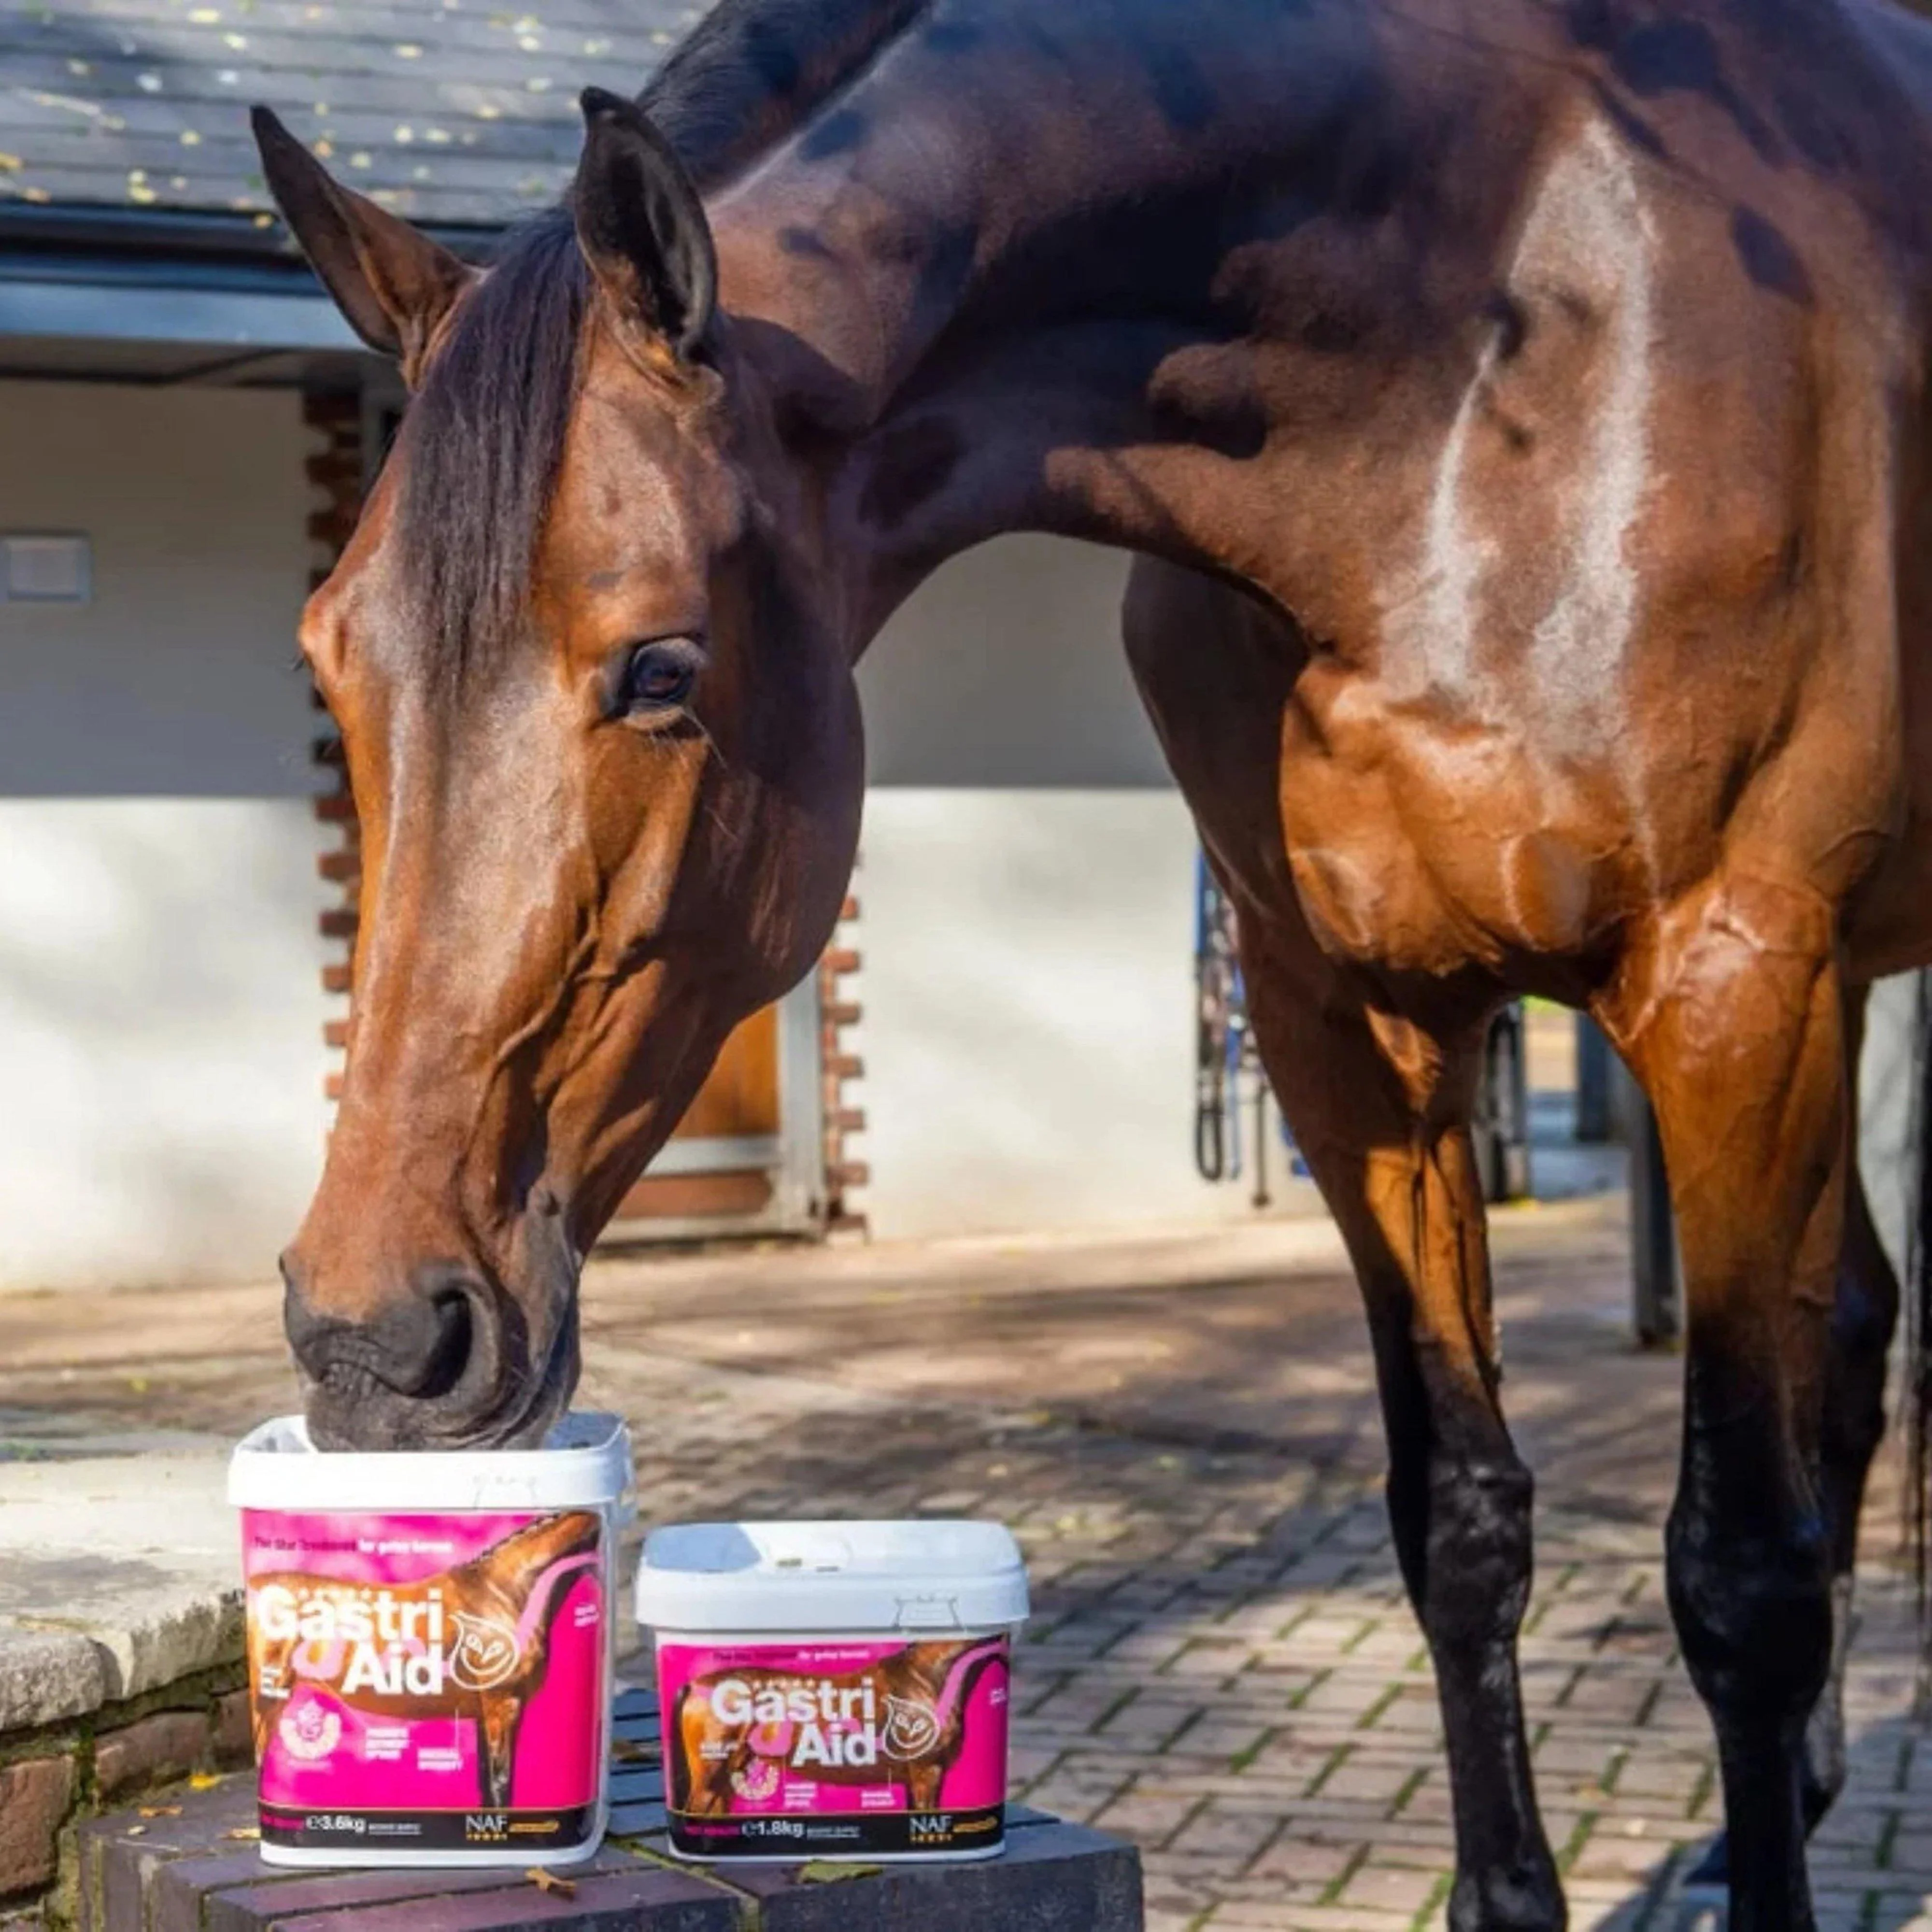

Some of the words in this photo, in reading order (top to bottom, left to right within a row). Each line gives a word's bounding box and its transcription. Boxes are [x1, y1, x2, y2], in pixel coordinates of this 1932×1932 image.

[257, 1584, 443, 1641] Gastri
[341, 1642, 443, 1695] Aid
[711, 1676, 876, 1725] Gastri
[791, 1722, 877, 1767] Aid
[465, 1814, 508, 1833] NAF
[909, 1815, 953, 1834] NAF
